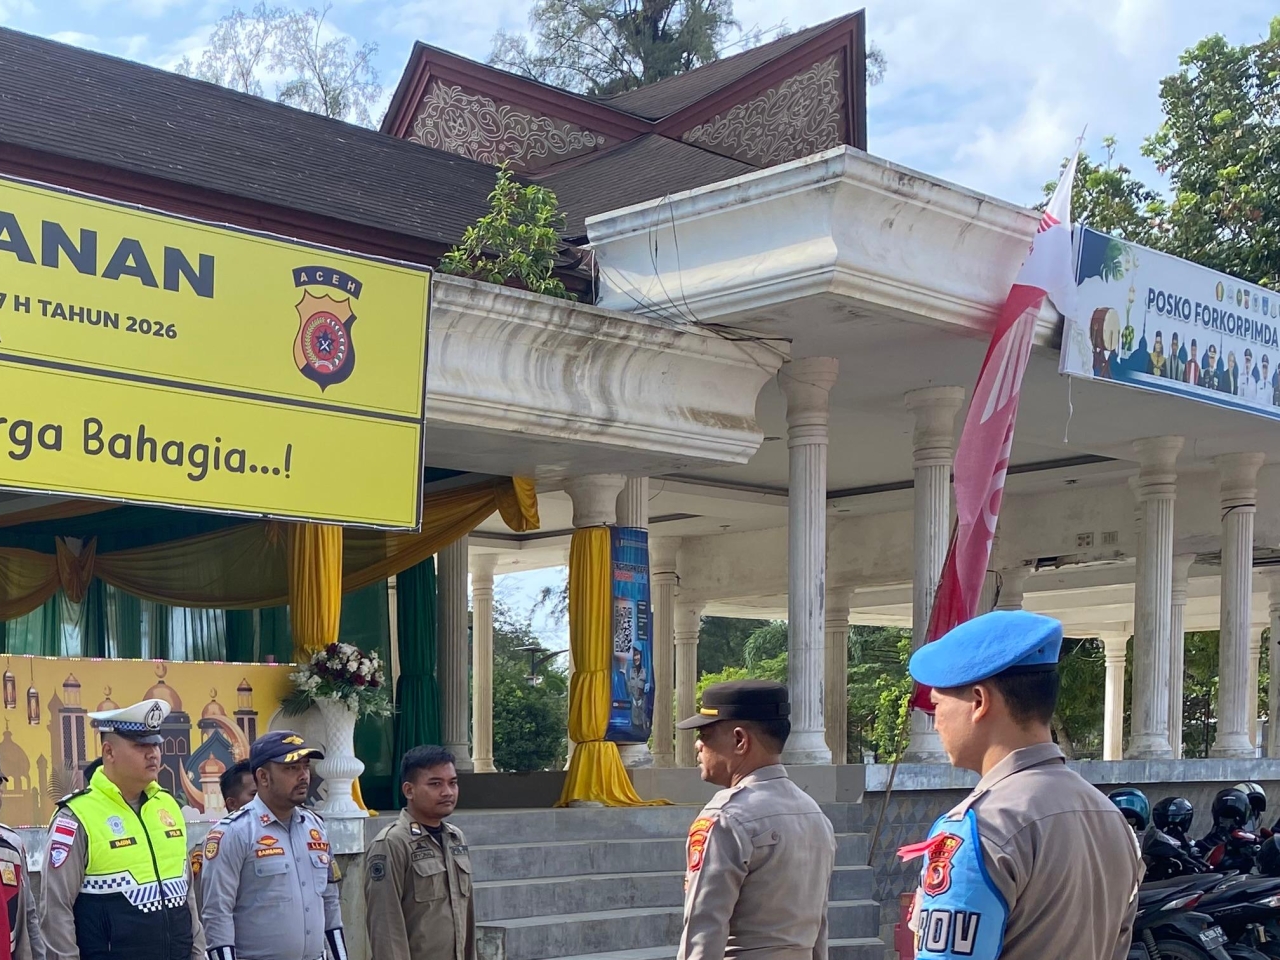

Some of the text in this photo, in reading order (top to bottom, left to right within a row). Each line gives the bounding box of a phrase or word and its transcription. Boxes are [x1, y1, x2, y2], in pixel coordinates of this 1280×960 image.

[300, 271, 356, 292] ACEH
[14, 294, 31, 314] H
[38, 299, 119, 329] TAHUN
[125, 316, 178, 340] 2026
[1147, 287, 1279, 348] POSKO FORKORPIMDA
[83, 417, 293, 482] Bahagia...!
